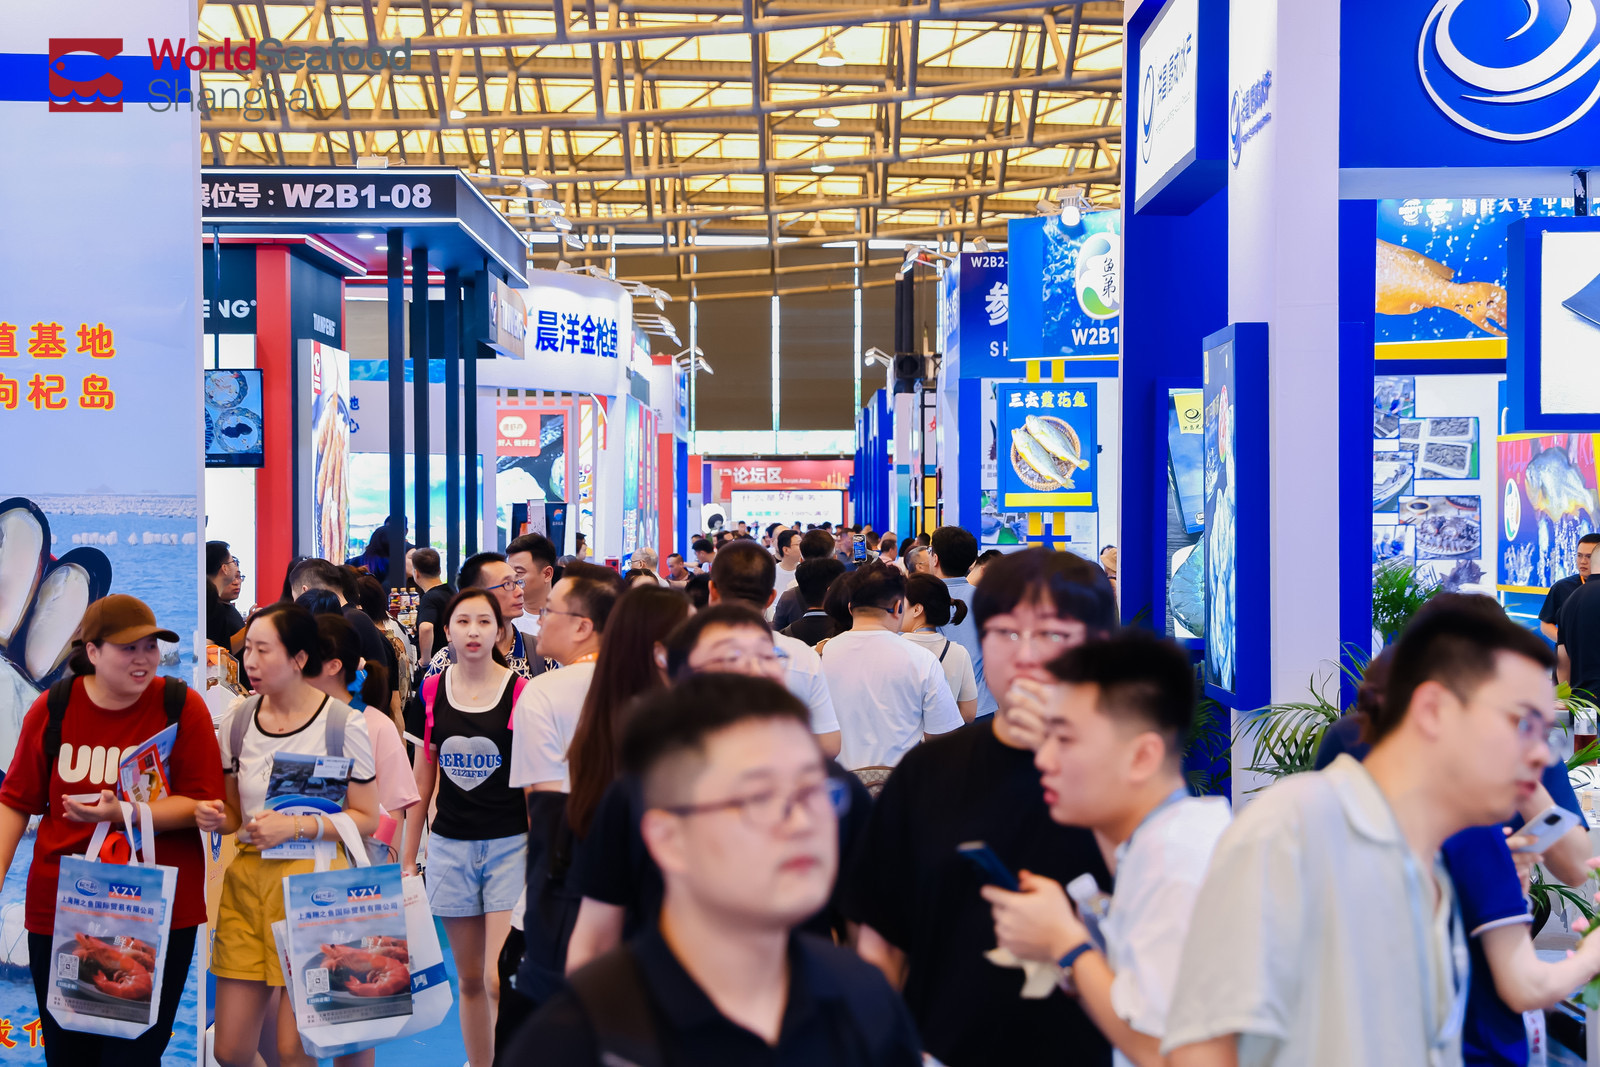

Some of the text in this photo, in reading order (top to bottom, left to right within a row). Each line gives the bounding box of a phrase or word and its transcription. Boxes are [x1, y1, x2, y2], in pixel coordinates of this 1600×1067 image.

[535, 310, 618, 359] 晨洋金枪鱼
[439, 753, 503, 769] SERIOUS
[111, 886, 139, 899] XZY
[349, 885, 379, 900] XZY
